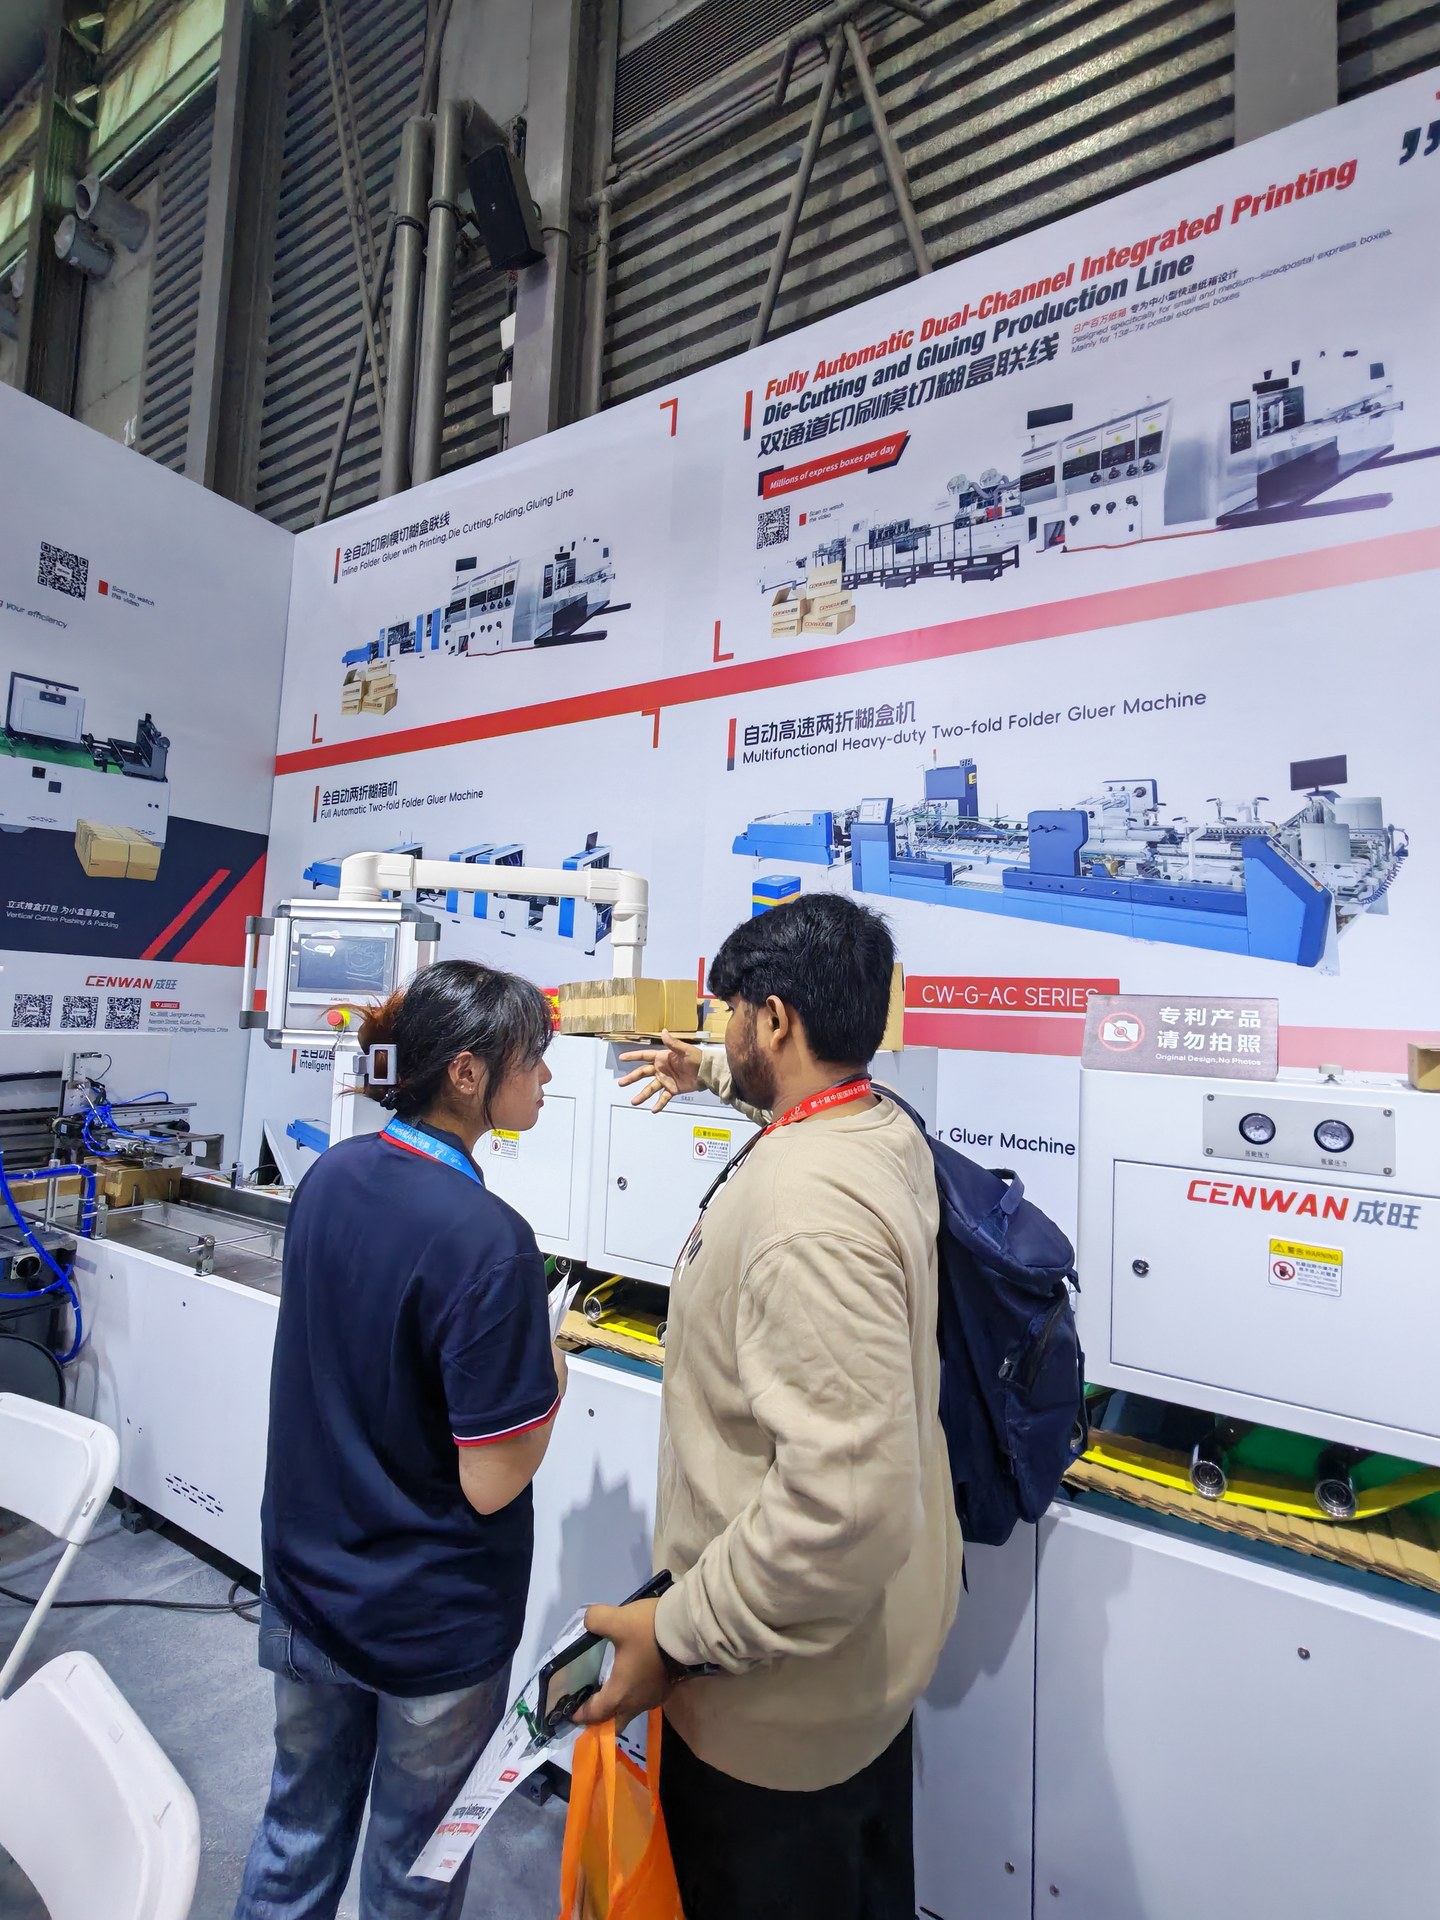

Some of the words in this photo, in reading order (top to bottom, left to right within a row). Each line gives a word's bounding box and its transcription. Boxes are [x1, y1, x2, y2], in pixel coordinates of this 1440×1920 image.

[765, 368, 809, 400] Fully
[813, 328, 915, 381] Automatic
[919, 262, 1075, 343] Dual-Channel
[1080, 204, 1224, 282] Integrated
[1230, 158, 1358, 225] Printing
[1159, 303, 1171, 316] for
[1199, 287, 1217, 302] and
[762, 379, 868, 427] Die-Cutting
[872, 353, 911, 387] and
[916, 329, 987, 372] Gluing
[992, 275, 1128, 343] Production
[1135, 253, 1195, 292] Line
[757, 331, 1060, 459] 双通道印刷模切糊盒联线
[769, 473, 799, 490] Millions
[799, 468, 808, 480] of
[809, 461, 839, 479] express
[839, 453, 864, 468] boxes
[864, 449, 879, 464] per
[880, 444, 897, 457] day
[341, 564, 359, 577] Inline
[359, 559, 381, 572] Folder
[382, 549, 401, 563] Gluer
[402, 544, 418, 556] with
[555, 487, 575, 502] Line
[343, 510, 451, 564] 全自动印刷模切糊盒联线
[6, 602, 26, 614] your
[27, 610, 68, 629] efficiency
[743, 700, 916, 746] 自动高速两折糊盒机
[743, 740, 838, 764] Multifunctional
[842, 728, 926, 751] Heavy-duty
[931, 717, 1002, 739] Two-fold
[1008, 710, 1062, 730] Folder
[1067, 702, 1116, 723] Gluer
[1122, 691, 1207, 715] Machine
[320, 809, 332, 819] Full
[333, 805, 366, 817] Automatic
[369, 799, 400, 812] Two-fold
[401, 797, 424, 809] Folder
[426, 794, 447, 806] Gluer
[449, 789, 484, 802] Machine
[322, 781, 398, 806] 全自动两折糊箱机
[6, 911, 33, 919] Vertical
[59, 916, 85, 926] Pushing
[93, 920, 119, 929] Packing
[85, 975, 153, 989] CENWAN
[153, 979, 178, 990] 成旺
[922, 985, 1018, 1006] CW-G-AC
[1159, 1006, 1261, 1029] 专利产品
[1157, 1030, 1261, 1054] 请勿拍照
[299, 1058, 331, 1072] Intelligent
[1155, 1053, 1186, 1062] Original
[1231, 1057, 1261, 1066] Photos
[949, 1127, 994, 1147] Gluer
[1000, 1132, 1076, 1156] Machine
[1187, 1179, 1350, 1221] CENWAN
[1352, 1200, 1422, 1230] 成旺
[1304, 1248, 1339, 1262] WARNING
